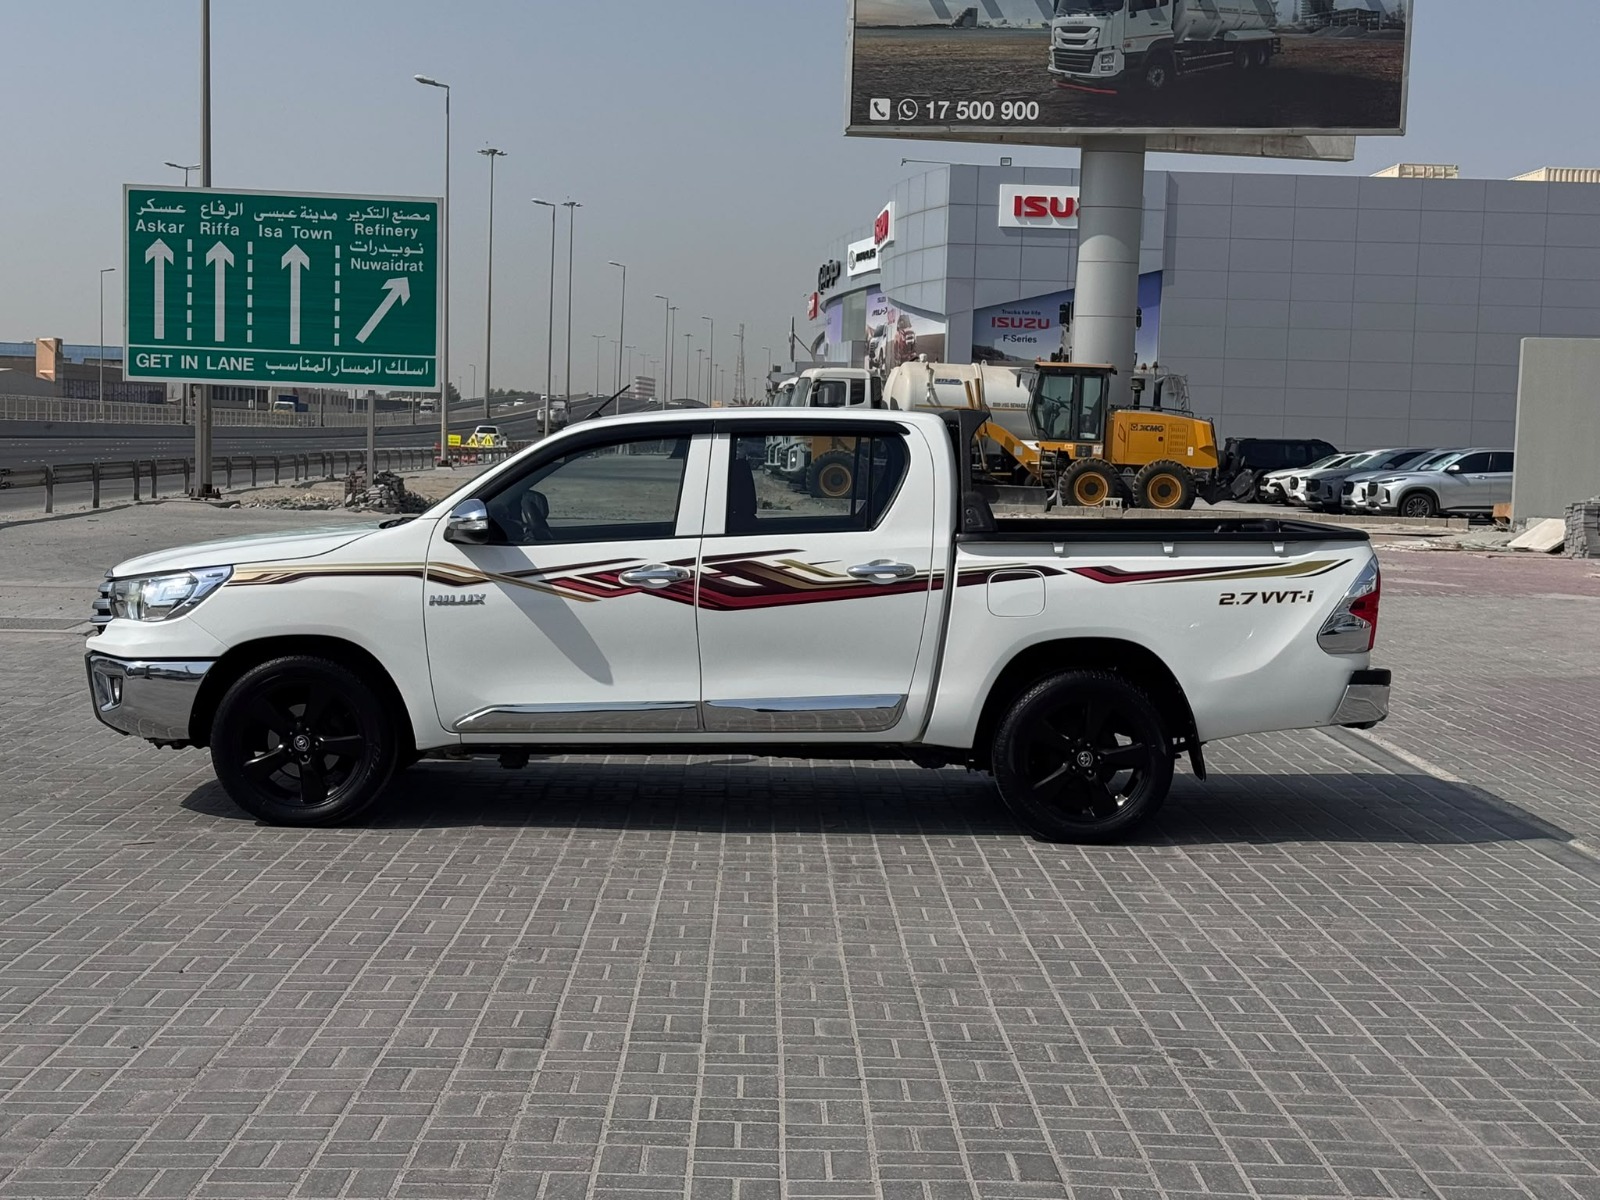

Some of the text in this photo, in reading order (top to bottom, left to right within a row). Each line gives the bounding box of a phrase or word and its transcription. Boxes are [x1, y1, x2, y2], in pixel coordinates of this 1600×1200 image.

[926, 101, 1040, 121] 17 500 900
[136, 198, 187, 216] عسكر
[200, 200, 244, 219] الرفاع
[254, 206, 338, 223] مدينة عيسى
[1013, 195, 1079, 218] ISU
[346, 206, 431, 224] مصنع التكرير
[135, 219, 185, 234] Askar
[200, 221, 240, 236] Riffa
[258, 224, 333, 240] Isa Town
[354, 223, 419, 240] Refinery
[349, 240, 424, 256] نويدرات
[351, 257, 424, 272] Nuwaidrat
[991, 316, 1050, 330] ISUZU
[1003, 334, 1038, 344] F-Series
[136, 353, 254, 371] GET IN LANE
[265, 356, 429, 377] اسلك المسار المناسب
[1139, 424, 1164, 433] XCMG
[429, 594, 486, 606] HILUX
[1218, 590, 1315, 606] 2.7 VVT-i
